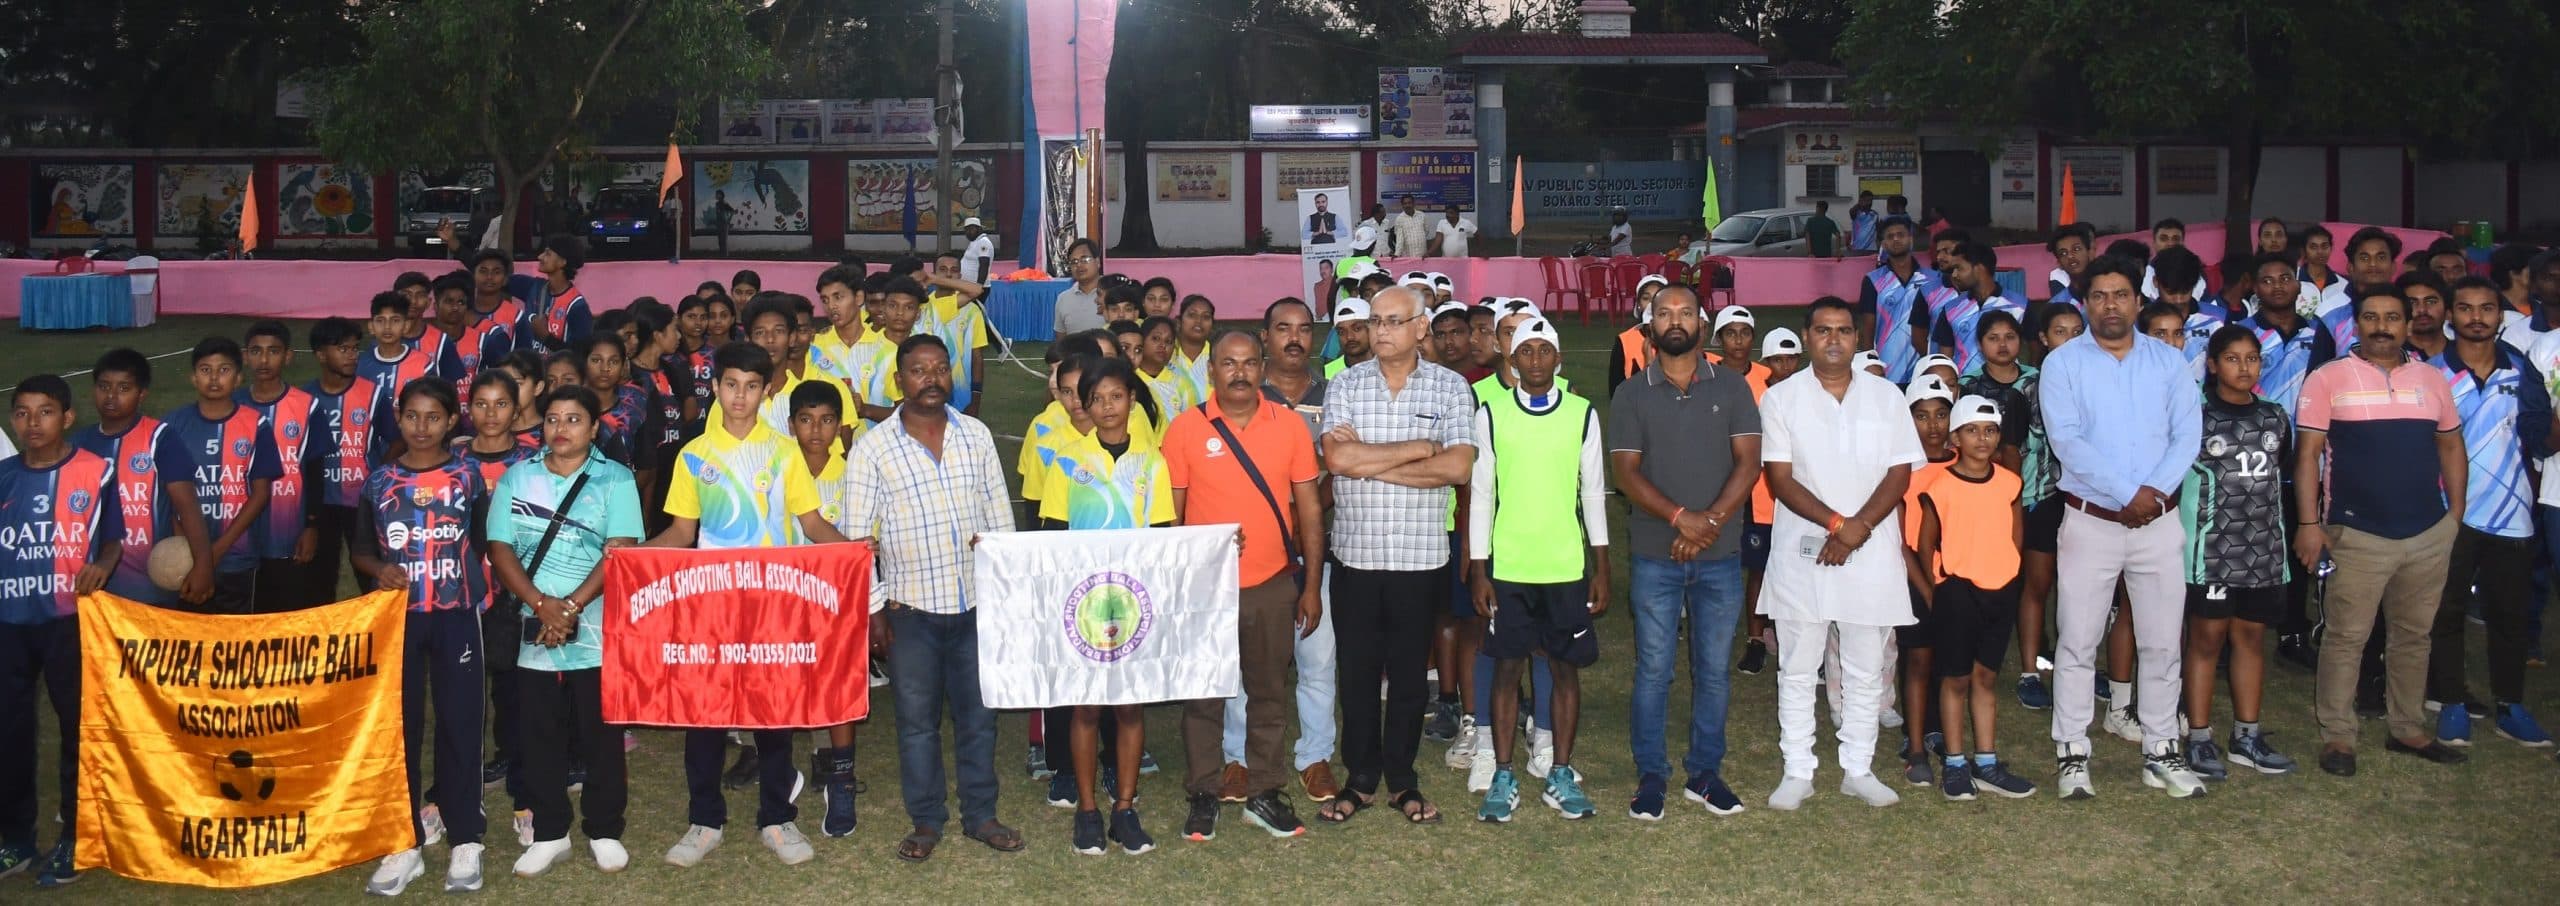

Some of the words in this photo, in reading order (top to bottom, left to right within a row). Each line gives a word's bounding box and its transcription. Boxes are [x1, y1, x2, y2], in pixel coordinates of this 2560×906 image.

[1411, 155, 1430, 165] DAV
[1506, 178, 1535, 192] DV
[1538, 178, 1585, 192] PUBLIC
[1588, 178, 1638, 192] SCHOOL
[1543, 195, 1591, 208] BOKARO
[1594, 194, 1629, 207] STEEL
[1633, 193, 1659, 206] CITY
[376, 372, 396, 388] 11
[693, 364, 711, 380] 13
[205, 438, 219, 455] 5
[330, 430, 364, 448] TAR
[2235, 450, 2268, 477] 12
[195, 464, 247, 484] ATAR
[323, 465, 365, 483] PURA
[32, 494, 50, 514] 3
[438, 485, 466, 512] 12
[201, 502, 243, 520] PURA
[0, 520, 86, 550] QATAR
[411, 523, 465, 543] Spotify
[16, 545, 84, 562] AIRWAYS
[397, 558, 464, 583] IPURA
[630, 575, 675, 624] BENGAL
[674, 563, 733, 601] SHOOTING
[734, 560, 763, 591] BALL
[765, 562, 840, 616] ASSOCIATION
[209, 634, 320, 690] SHOOTING
[323, 631, 378, 685] BALL
[177, 696, 301, 740] ASSOCIATION
[181, 810, 307, 859] AGARTALA
